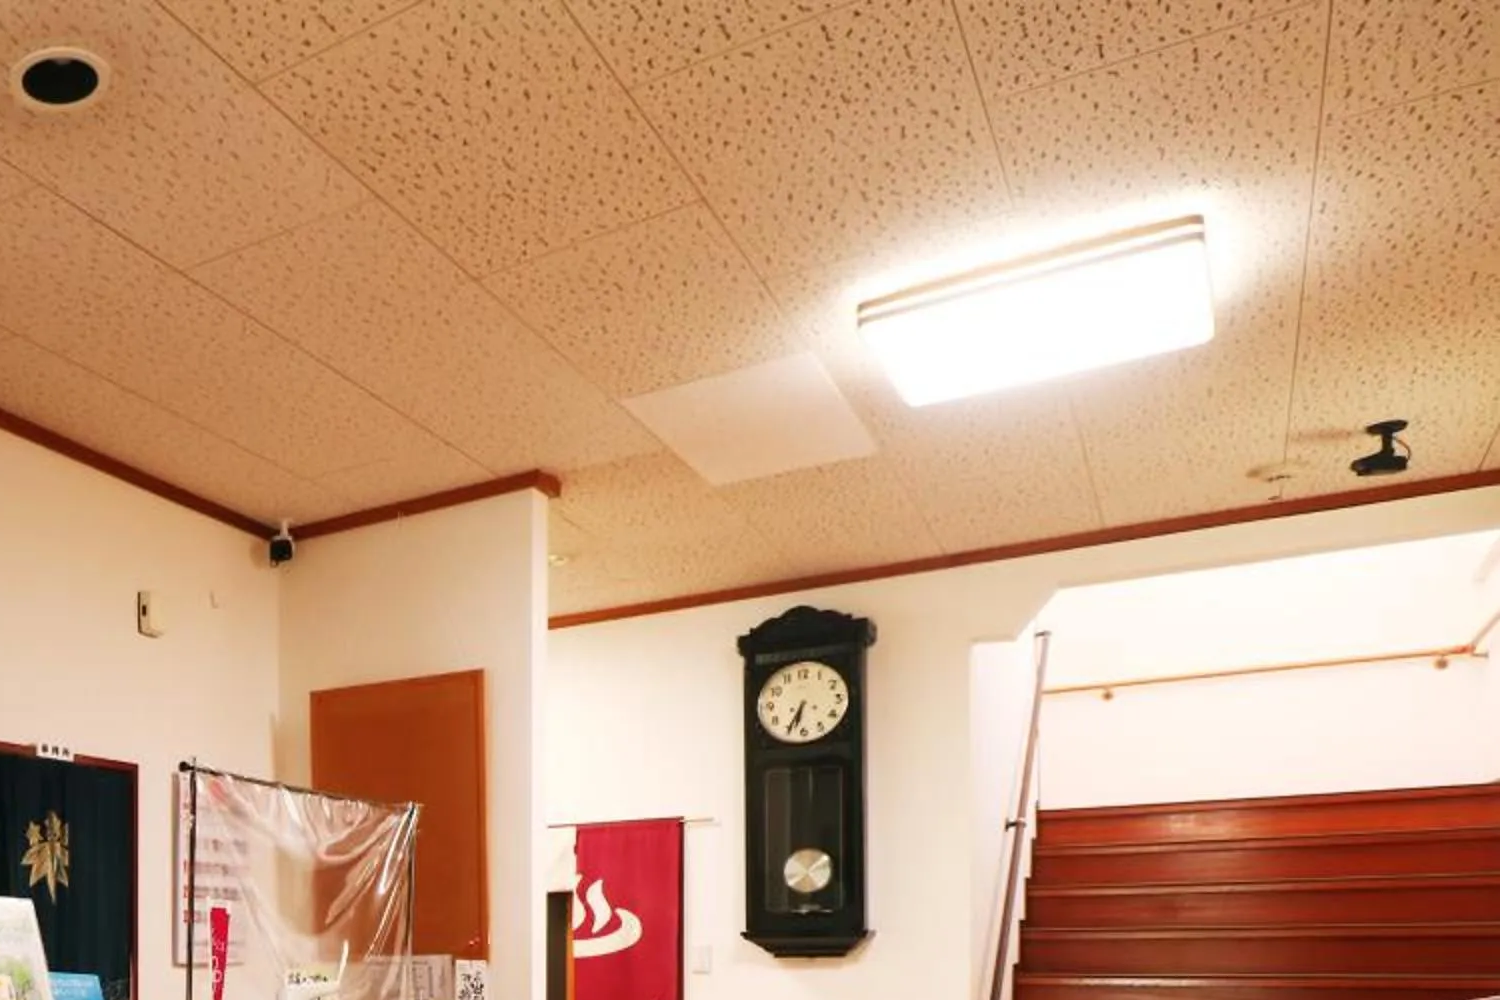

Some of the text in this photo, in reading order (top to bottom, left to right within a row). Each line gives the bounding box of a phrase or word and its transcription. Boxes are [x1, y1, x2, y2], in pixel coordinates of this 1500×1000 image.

[783, 671, 792, 684] 11
[797, 668, 810, 680] 12
[817, 670, 823, 681] 1
[827, 679, 838, 691] 2
[770, 685, 783, 698] 10
[835, 693, 844, 705] 3
[765, 701, 775, 712] 9
[827, 708, 838, 719] 4
[771, 715, 780, 726] 8
[799, 727, 810, 737] 6
[816, 721, 825, 733] 5
